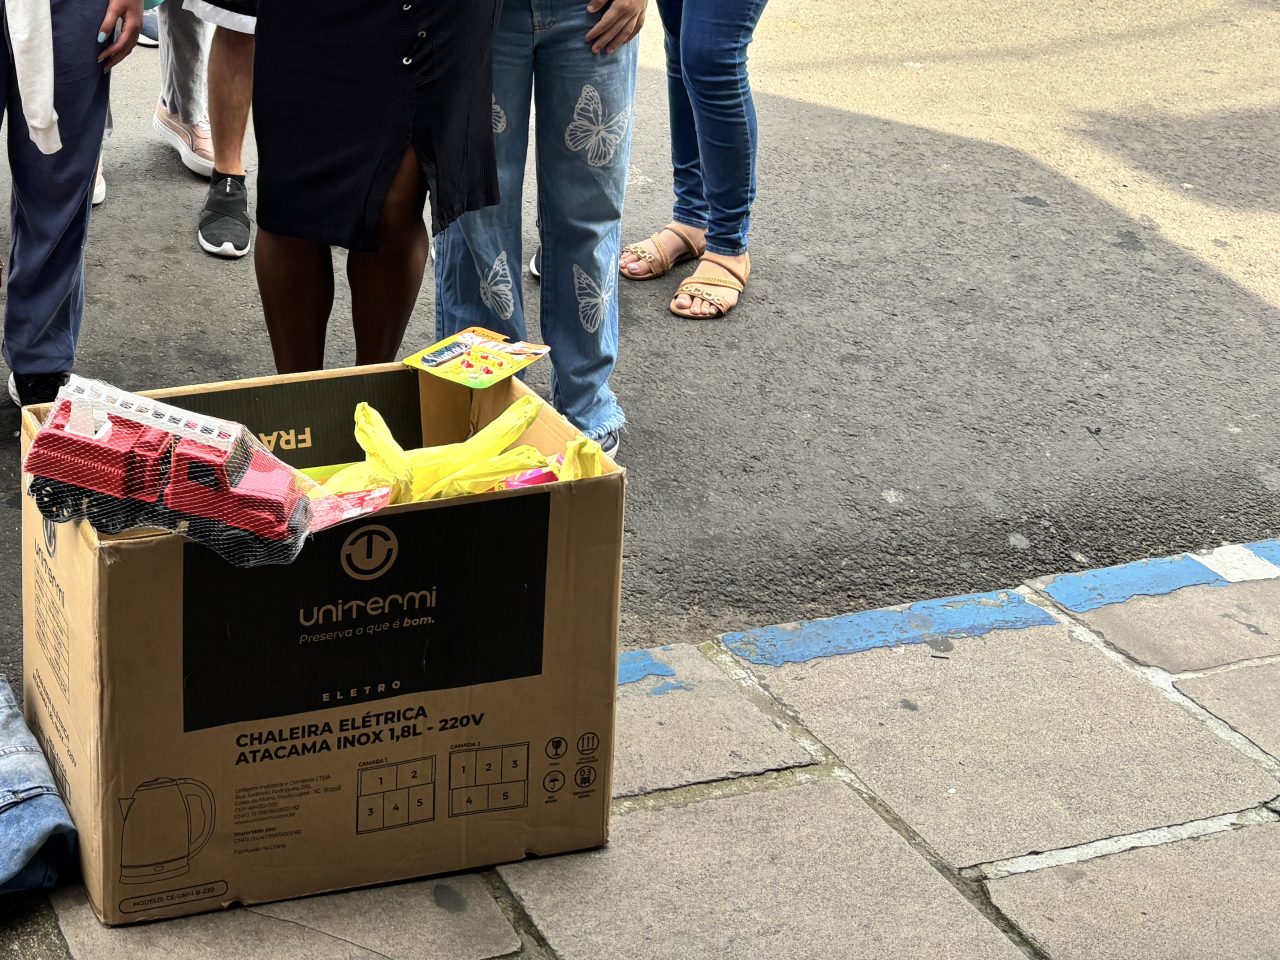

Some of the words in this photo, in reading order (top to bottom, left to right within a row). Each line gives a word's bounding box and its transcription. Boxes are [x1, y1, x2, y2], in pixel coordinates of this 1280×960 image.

[258, 426, 313, 453] FRA
[299, 626, 353, 644] Preserva
[355, 626, 365, 636] o
[366, 620, 390, 636] que
[392, 617, 401, 630] é
[403, 615, 436, 629] bom.
[322, 679, 402, 702] ELETRO
[234, 721, 333, 749] CHALEIRA
[338, 704, 428, 733] ELÉTRICA
[234, 740, 331, 766] ATACAMA
[336, 728, 384, 751] INOX
[388, 723, 422, 743] 1,8L
[438, 712, 486, 732] 220V
[485, 762, 493, 772] 2
[511, 759, 519, 769] 3
[411, 770, 418, 780] 2
[465, 795, 473, 805] 4
[502, 791, 510, 801] 5
[392, 802, 400, 813] 4
[416, 798, 424, 808] 5
[367, 807, 375, 817] 3
